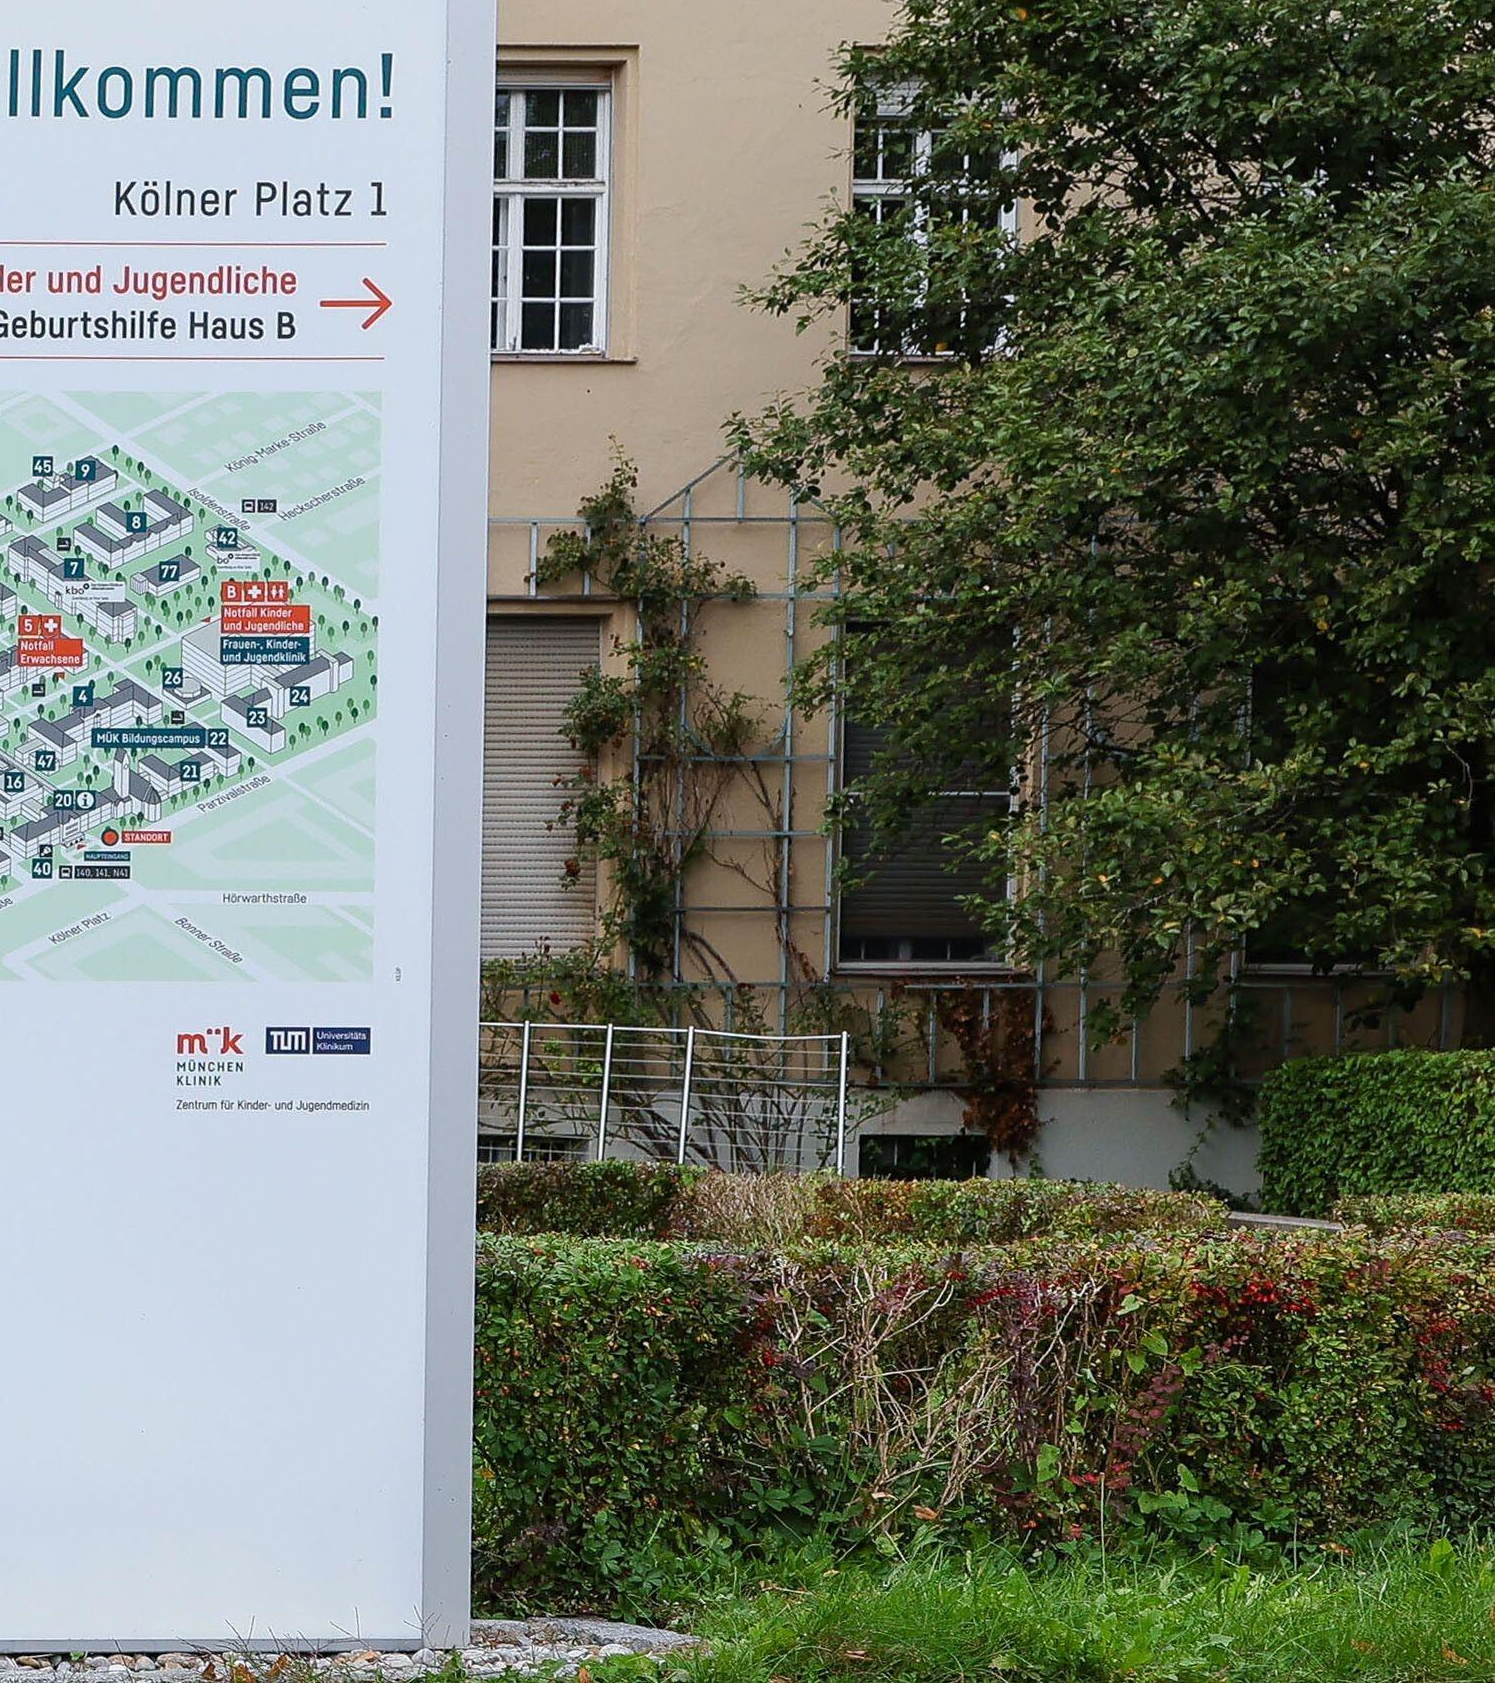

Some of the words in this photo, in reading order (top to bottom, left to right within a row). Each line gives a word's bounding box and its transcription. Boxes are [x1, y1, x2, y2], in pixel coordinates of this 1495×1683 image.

[114, 181, 237, 217] Kölner
[255, 181, 353, 217] Platz
[371, 183, 388, 216] 1
[48, 265, 102, 296] und
[114, 266, 297, 301] Jugendliche
[189, 311, 264, 340] Haus
[277, 313, 296, 340] B
[225, 421, 327, 473] König-Marke-Straße
[33, 460, 52, 472] 45
[187, 488, 251, 531] Isoldenstraße
[161, 565, 177, 578] 77
[227, 586, 236, 598] B
[224, 608, 257, 617] Notfall
[261, 608, 292, 617] Kinder
[24, 619, 32, 632] 5
[224, 622, 242, 631] und
[246, 622, 303, 633] Jugendliche
[20, 641, 54, 650] Notfall
[266, 640, 301, 649] Kinder-
[20, 655, 80, 664] Erwachsene
[223, 653, 241, 662] und
[244, 652, 306, 664] Jugendklinik
[250, 712, 265, 724] 23
[97, 732, 119, 744] MÜK
[122, 733, 201, 745] Bildungscampus
[210, 732, 226, 745] 22
[182, 766, 197, 778] 21
[197, 773, 271, 813] Parzivalstraße
[125, 833, 168, 841] STANDORT
[222, 892, 307, 905] Hörwarthstraße
[49, 919, 85, 945] Kölner
[82, 910, 111, 932] Platz
[175, 917, 212, 944] Bonner
[208, 939, 242, 965] Straße
[317, 1031, 367, 1040] Universitäts
[177, 1060, 244, 1072] MÜNCHEN
[177, 1076, 221, 1086] KLINIK
[177, 1100, 217, 1110] Zentrum
[221, 1099, 234, 1110] für
[237, 1100, 271, 1110] Kinder-
[275, 1100, 293, 1110] und
[296, 1101, 370, 1112] Jugendmedizin
